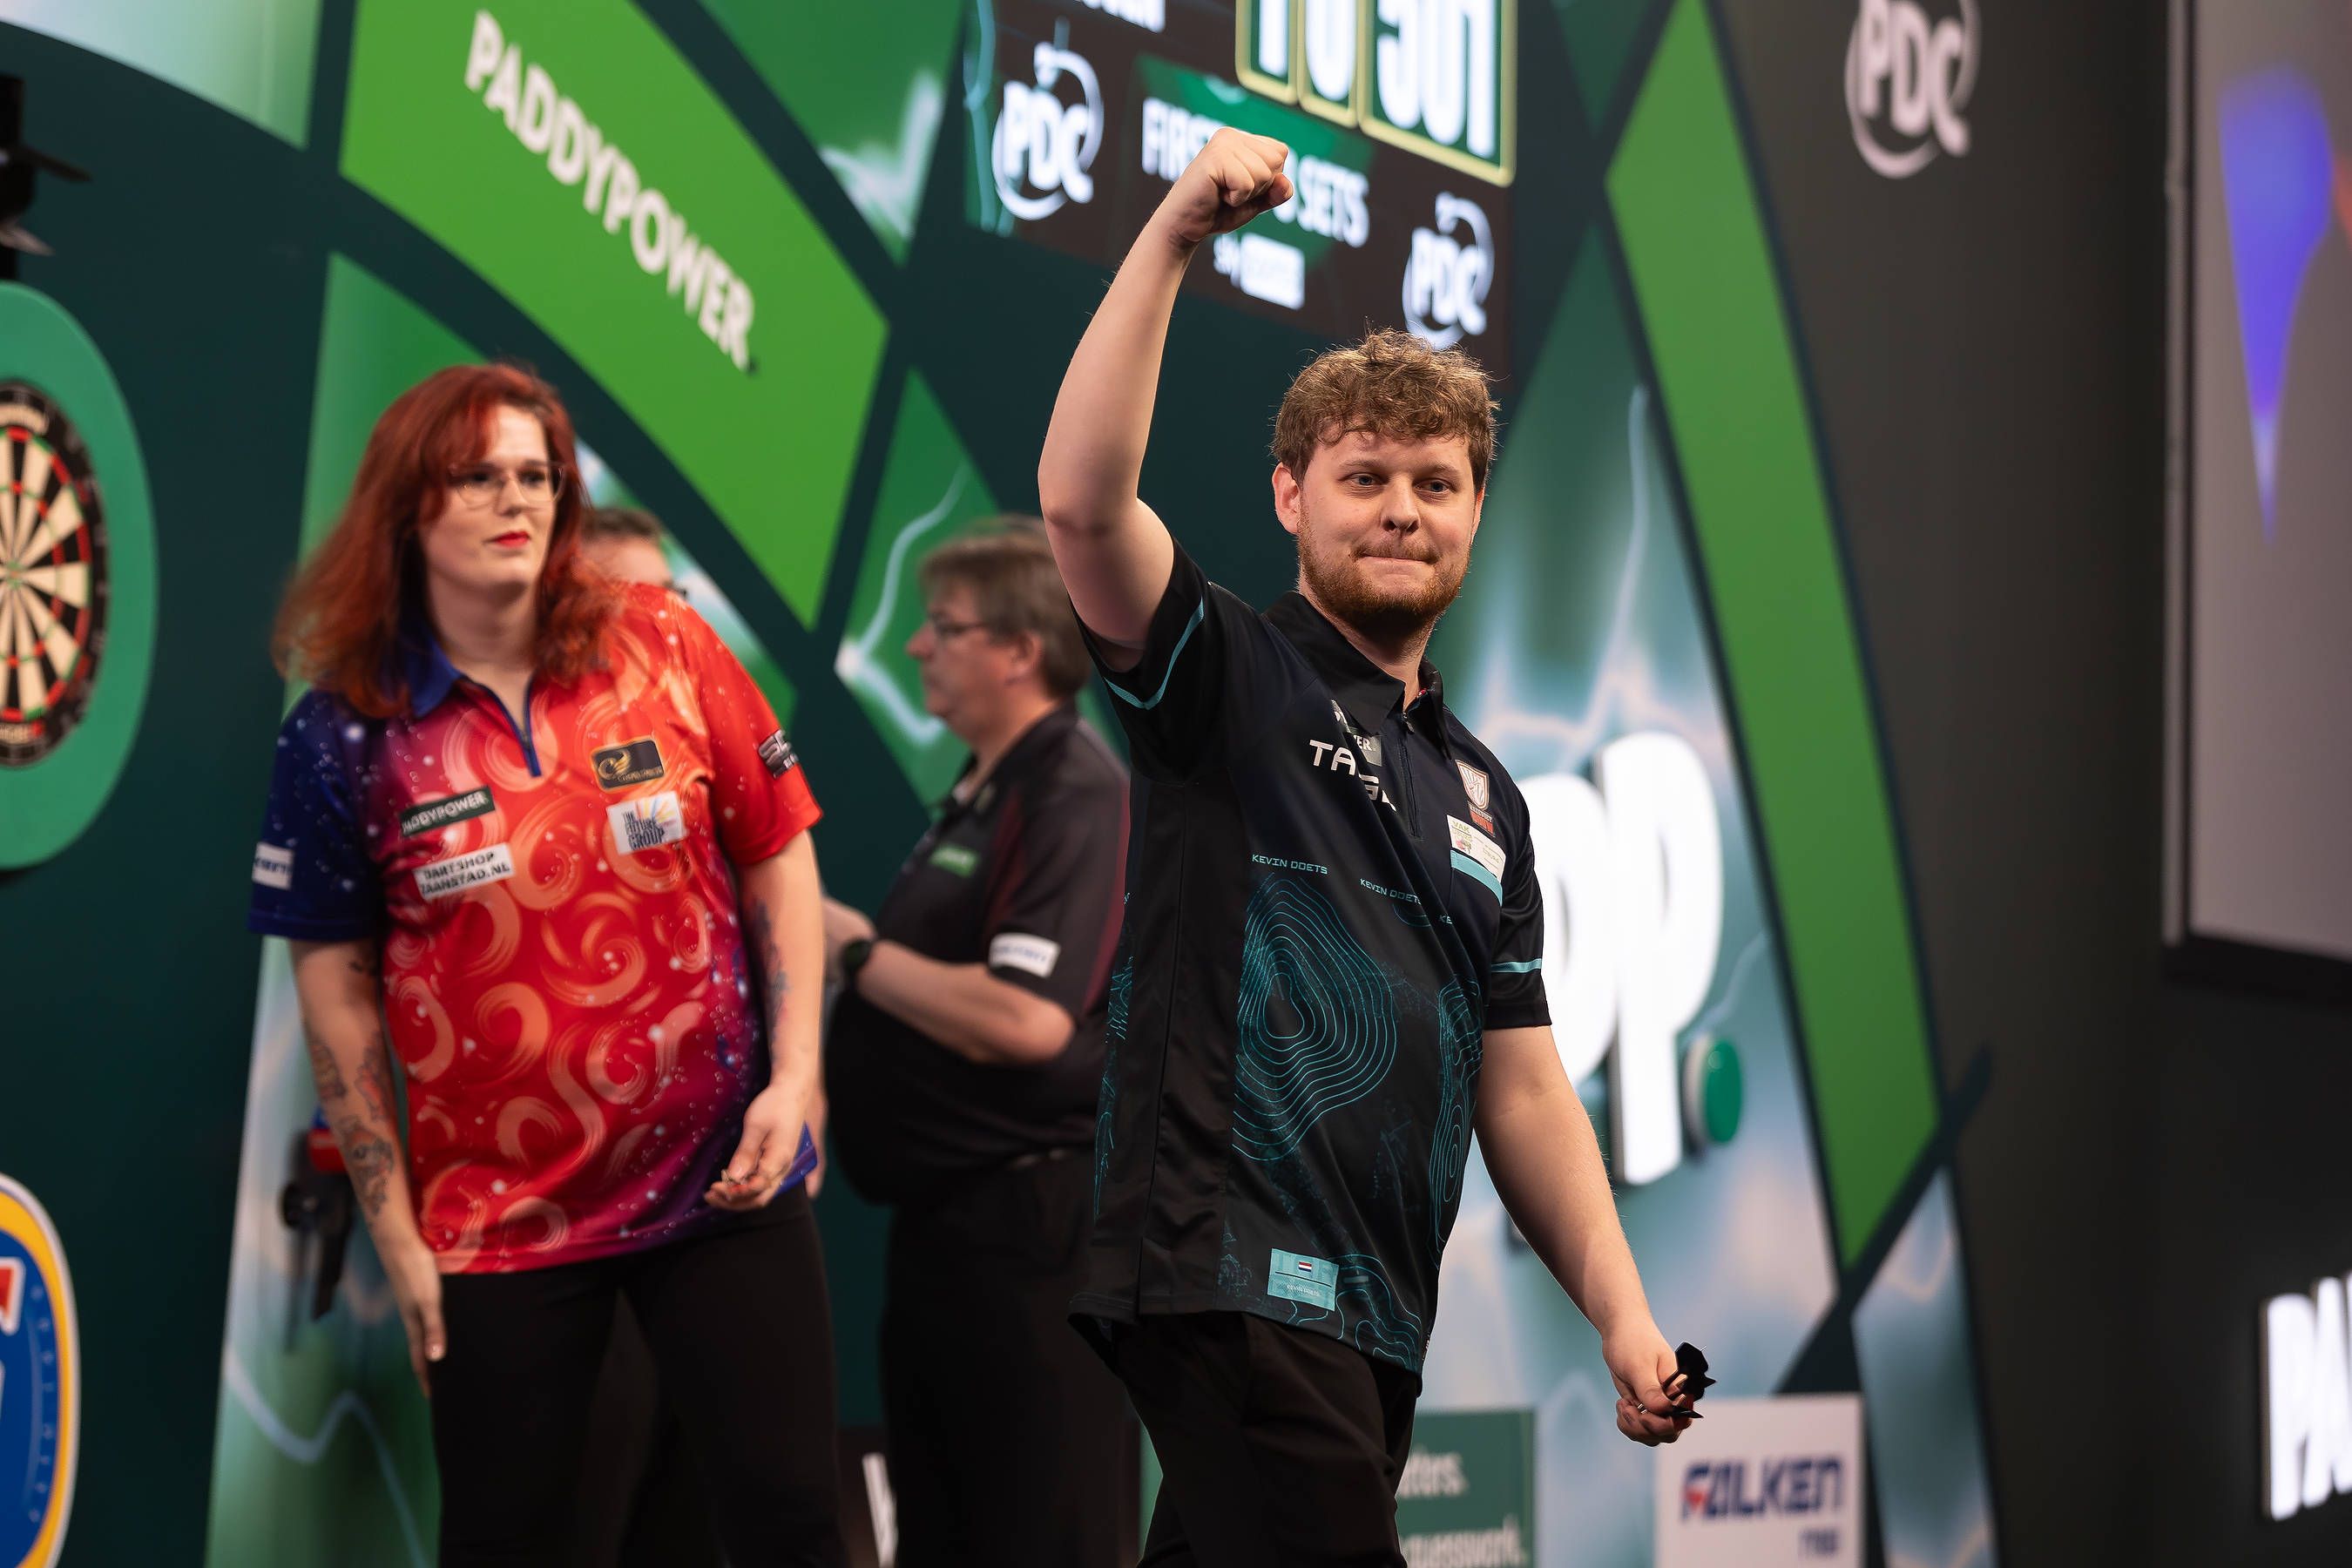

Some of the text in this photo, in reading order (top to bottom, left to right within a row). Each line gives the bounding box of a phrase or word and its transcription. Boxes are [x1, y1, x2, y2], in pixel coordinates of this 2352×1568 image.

[1252, 855, 1288, 868] KEVIN
[1360, 878, 1388, 896] KEVIN
[1682, 1458, 1843, 1521] FALKEN
